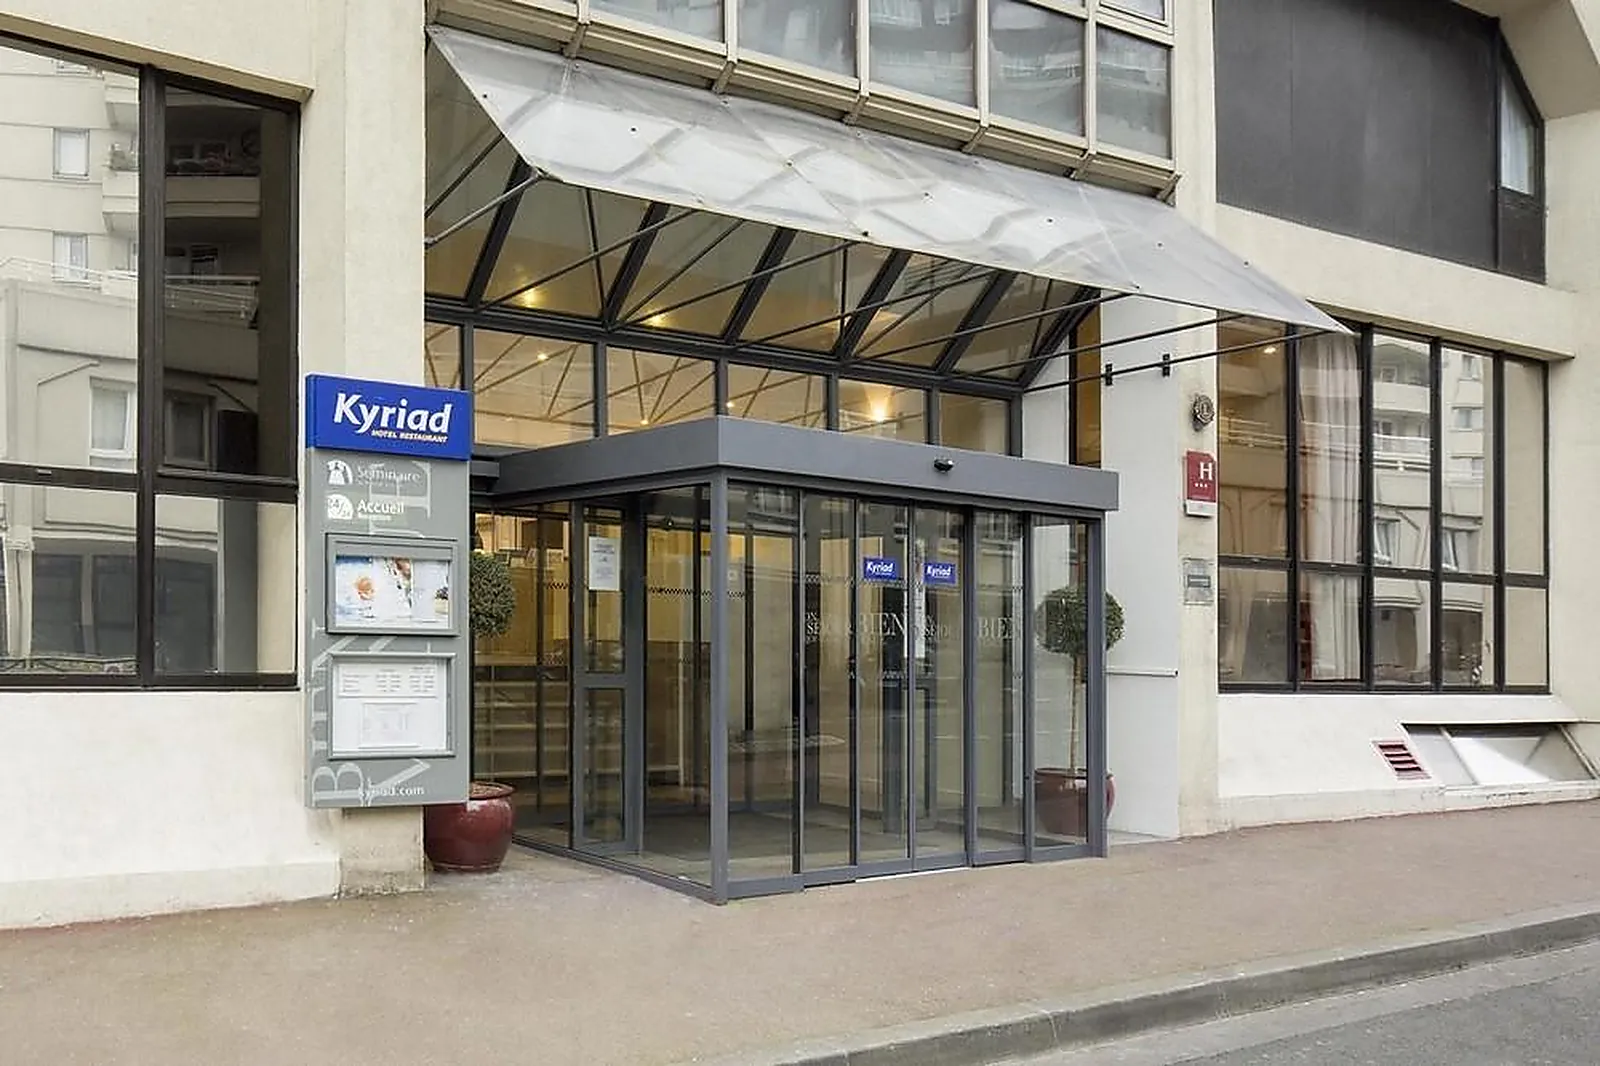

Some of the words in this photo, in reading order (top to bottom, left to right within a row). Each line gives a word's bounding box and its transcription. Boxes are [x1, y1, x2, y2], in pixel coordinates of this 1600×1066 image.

[333, 392, 453, 434] Kyriad
[399, 432, 449, 443] RESTAURANT
[1199, 462, 1213, 481] H
[357, 499, 405, 515] Accueil
[866, 561, 894, 574] Kyriad
[926, 565, 952, 577] Kyriad
